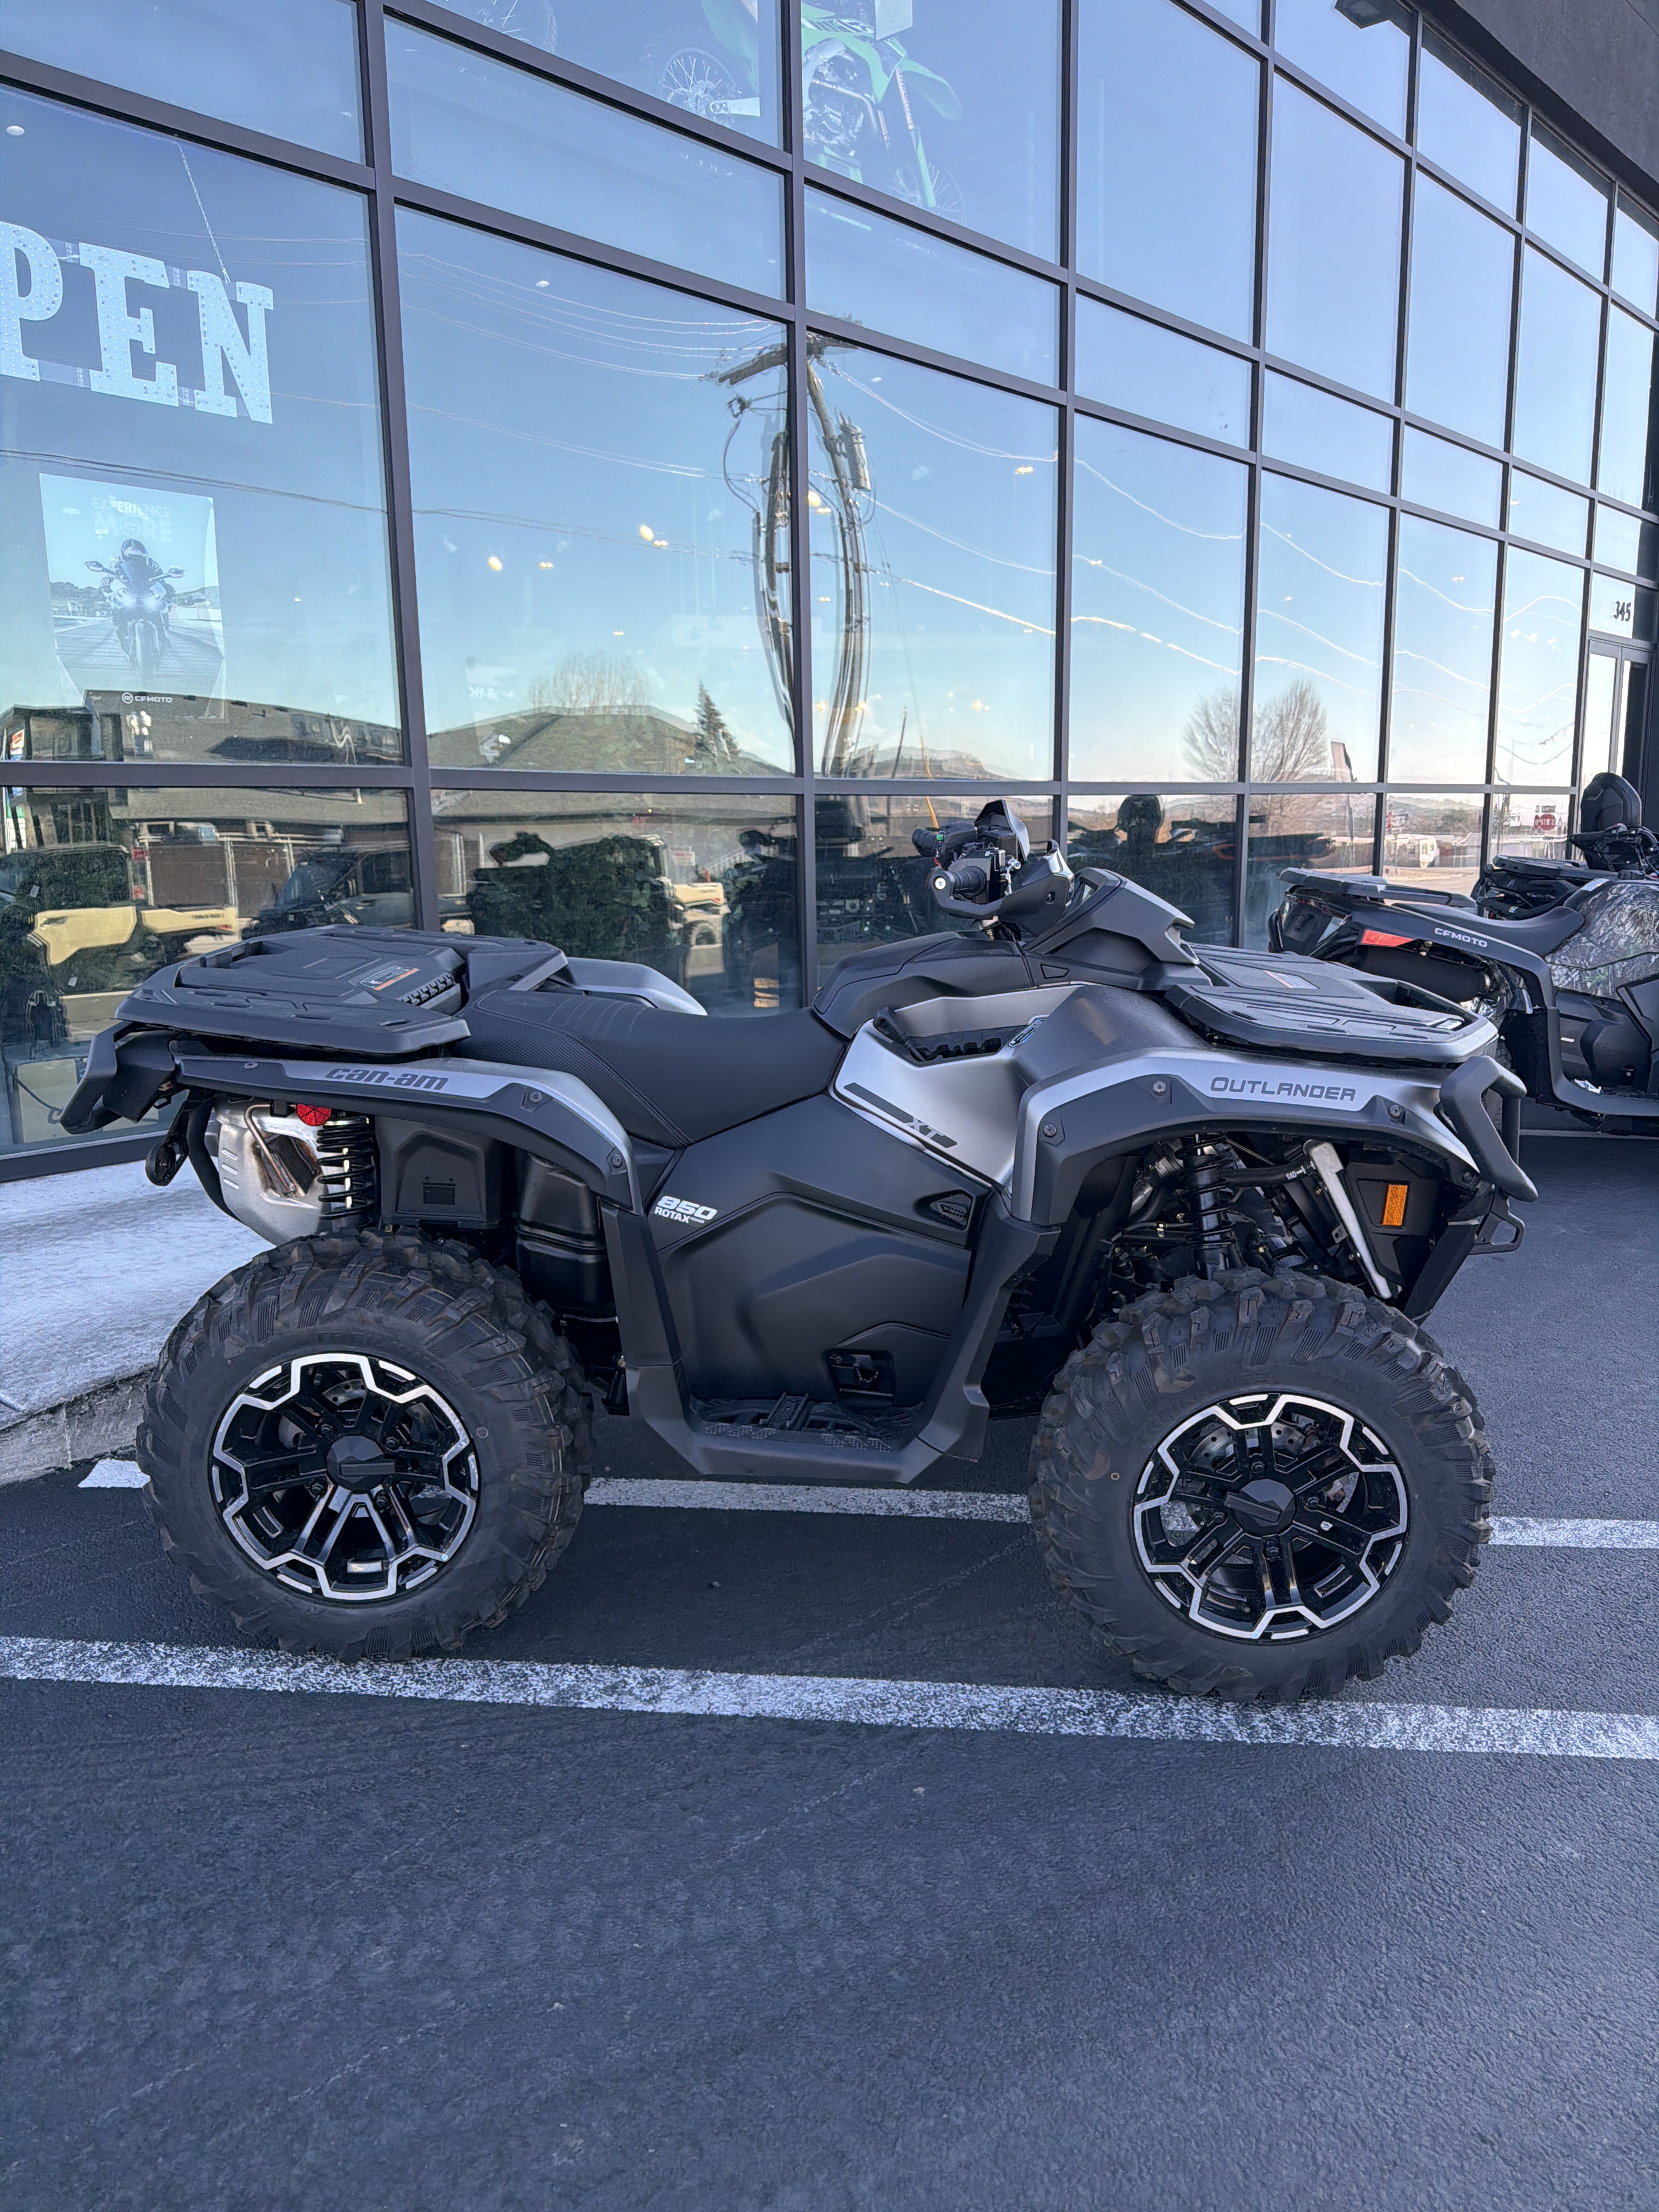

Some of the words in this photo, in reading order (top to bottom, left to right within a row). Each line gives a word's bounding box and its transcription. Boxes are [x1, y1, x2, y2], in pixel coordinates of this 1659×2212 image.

[92, 497, 171, 518] EXPERIENCE
[1613, 600, 1632, 622] 345
[134, 695, 172, 703] CFMOTO
[1434, 927, 1488, 948] CFMOTO
[325, 1068, 449, 1091] can-am
[1210, 1071, 1356, 1102] OUTLANDER
[904, 1116, 944, 1139] XT
[654, 1206, 690, 1224] ROTAX
[657, 1195, 718, 1220] 850
